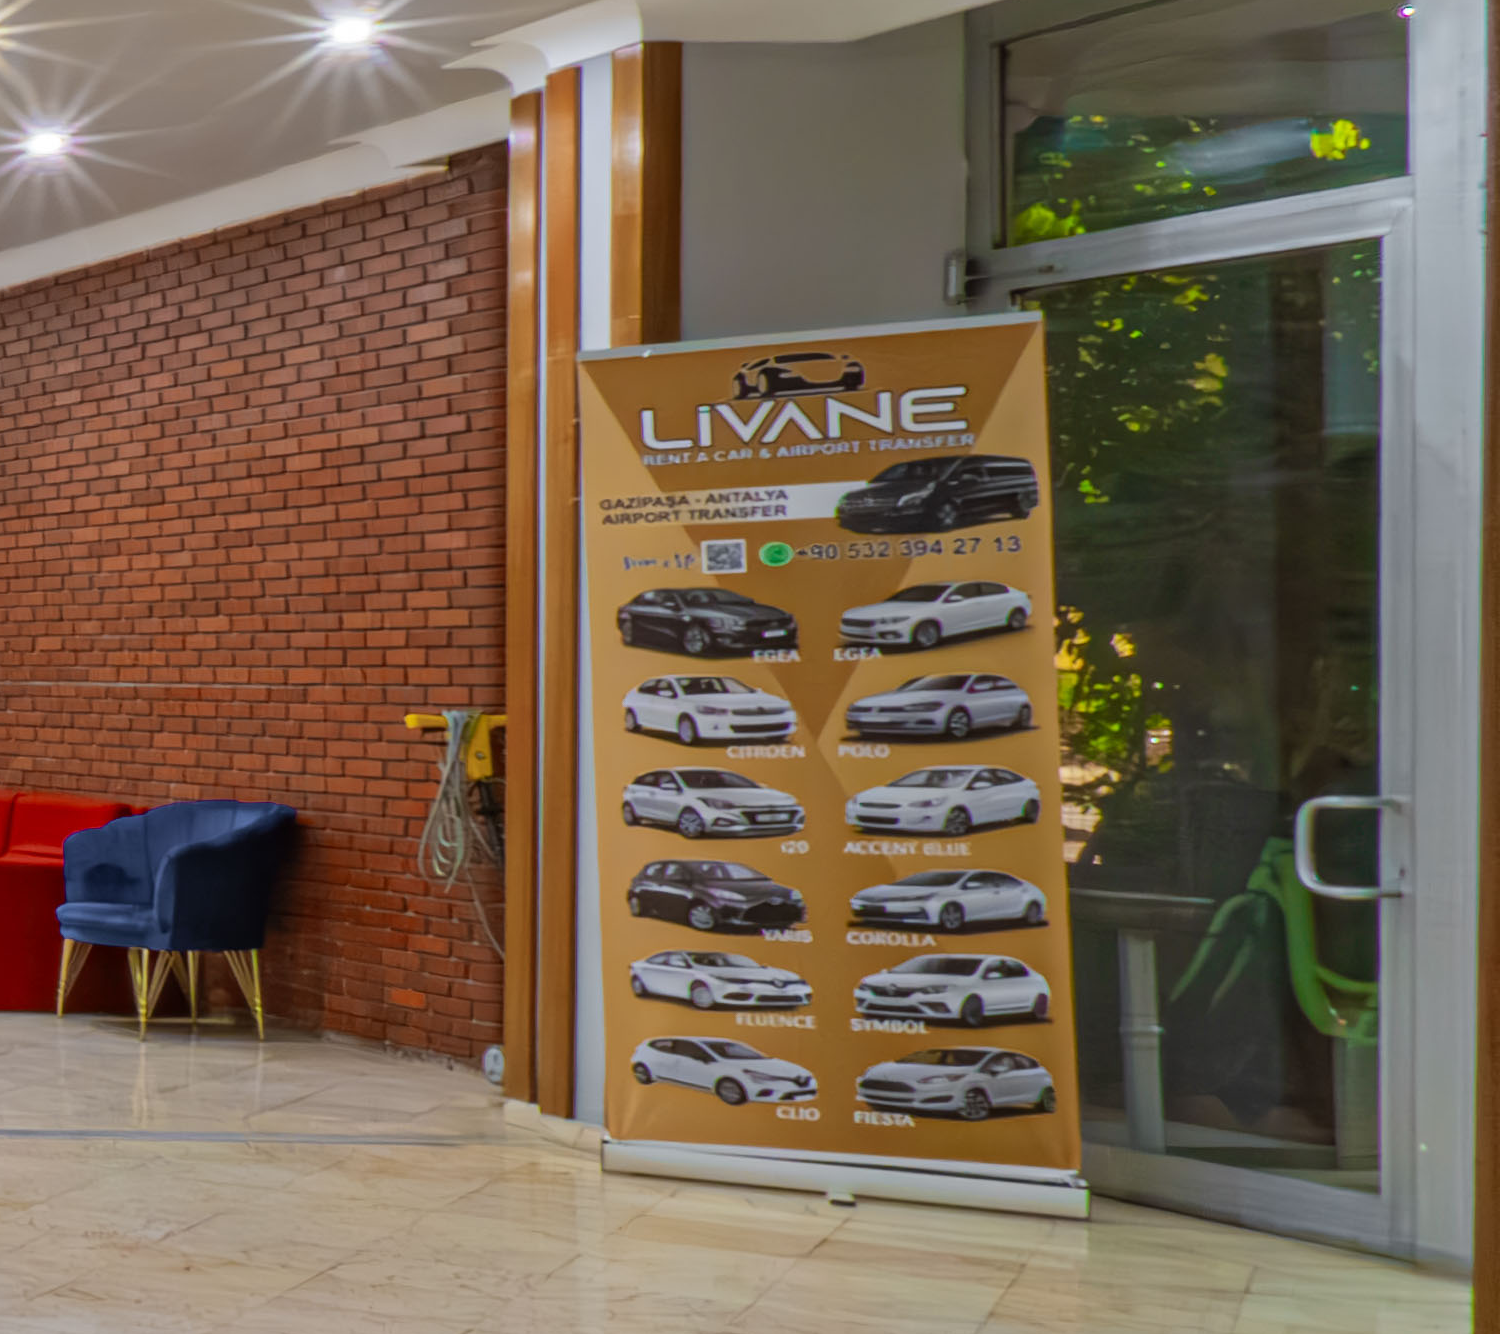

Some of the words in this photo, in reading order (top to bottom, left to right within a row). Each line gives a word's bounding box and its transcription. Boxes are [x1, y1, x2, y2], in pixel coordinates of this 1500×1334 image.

[643, 452, 691, 466] RENT
[695, 451, 709, 463] A
[714, 448, 753, 462] CAR
[776, 440, 860, 458] AIRPORT
[869, 433, 975, 451] TRANSFER
[705, 489, 788, 505] ANTALYA
[602, 509, 681, 525] AIRPORT
[688, 504, 787, 521] TRANSFER
[848, 541, 891, 559] 532
[900, 539, 943, 556] 394
[953, 537, 981, 555] 27
[993, 535, 1022, 553] 13
[833, 647, 883, 661] EGEA
[838, 744, 890, 758] POLO
[844, 840, 918, 855] ACCENT
[923, 841, 972, 856] BLUE
[762, 928, 813, 943] YARIS
[845, 930, 937, 947] COROLLA
[735, 1012, 816, 1030] FLUENCE
[851, 1017, 930, 1035] SYMBOL
[775, 1105, 821, 1121] CLIO
[853, 1110, 916, 1127] FIESTA
